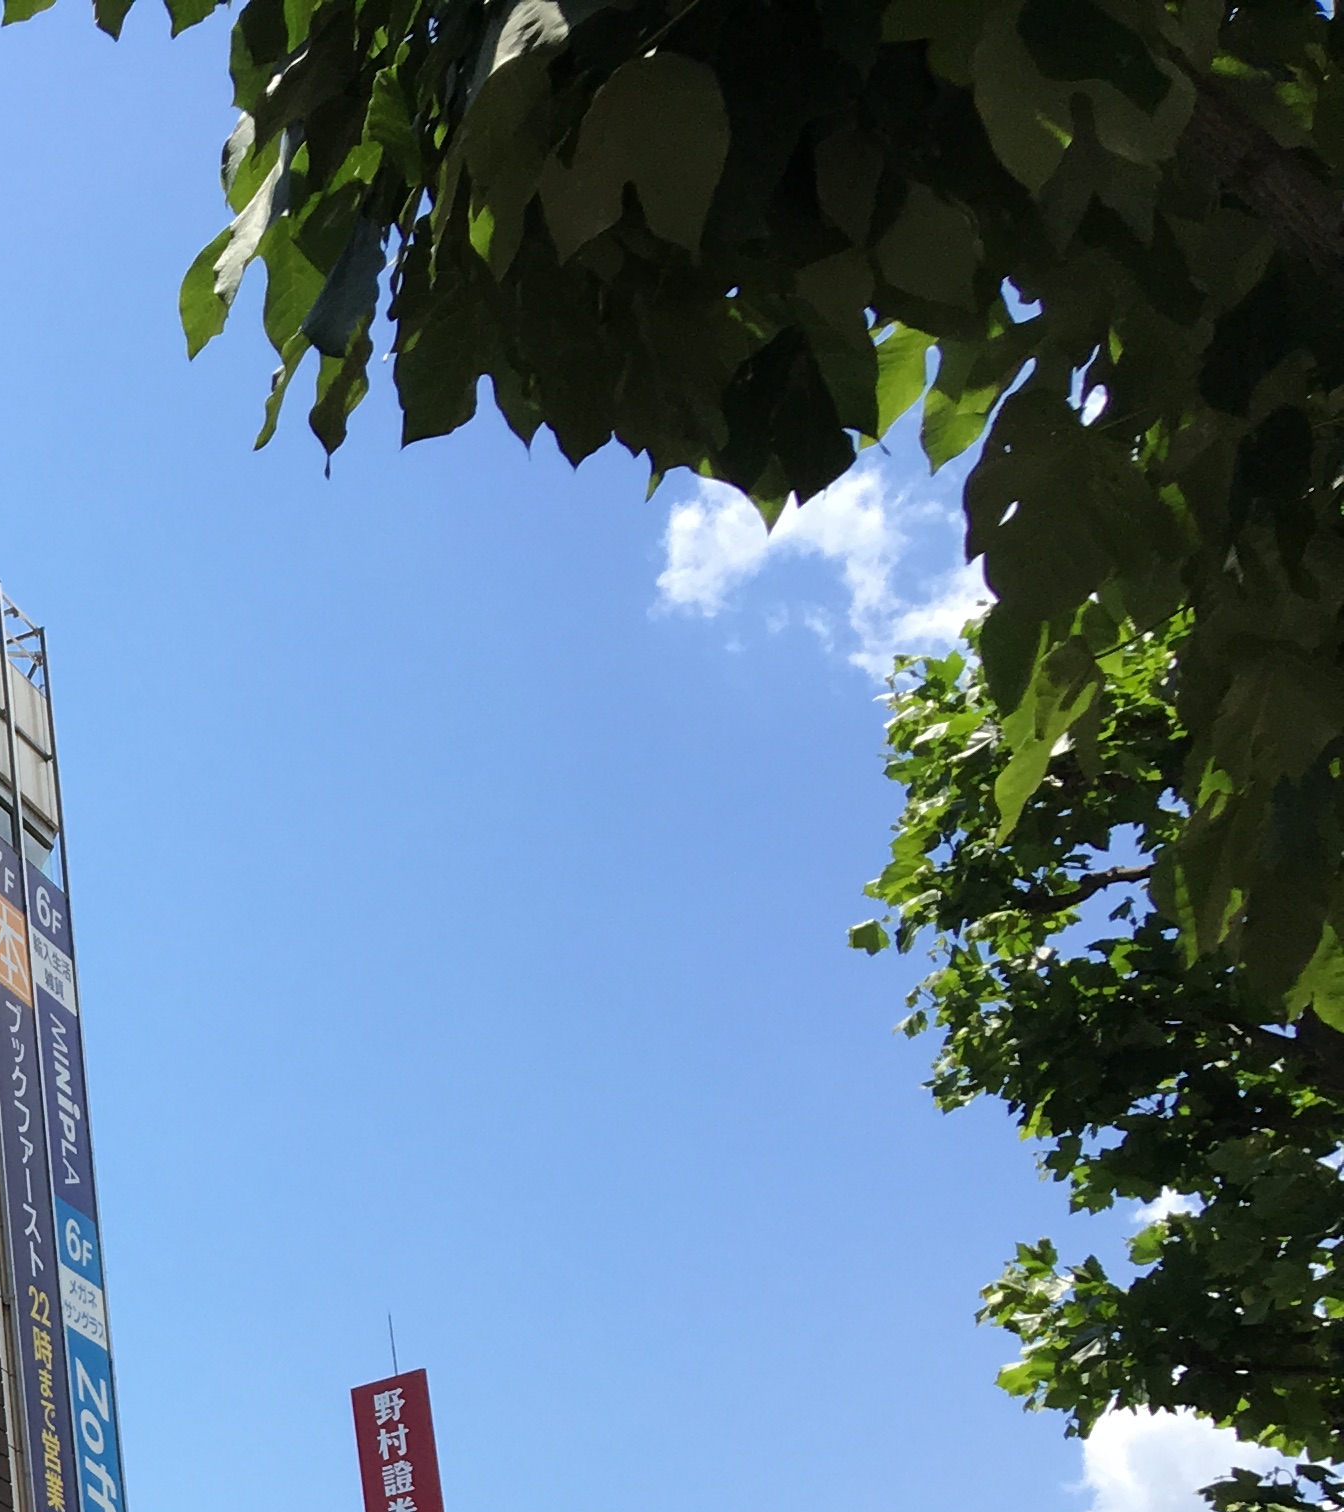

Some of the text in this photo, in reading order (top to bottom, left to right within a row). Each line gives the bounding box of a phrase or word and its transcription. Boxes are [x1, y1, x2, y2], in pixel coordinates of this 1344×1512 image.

[34, 885, 63, 935] 6F
[4, 1000, 45, 1278] ブックファースト
[64, 1218, 94, 1268] 6F
[68, 1278, 99, 1310] メガネ
[63, 1300, 108, 1342] サングラス
